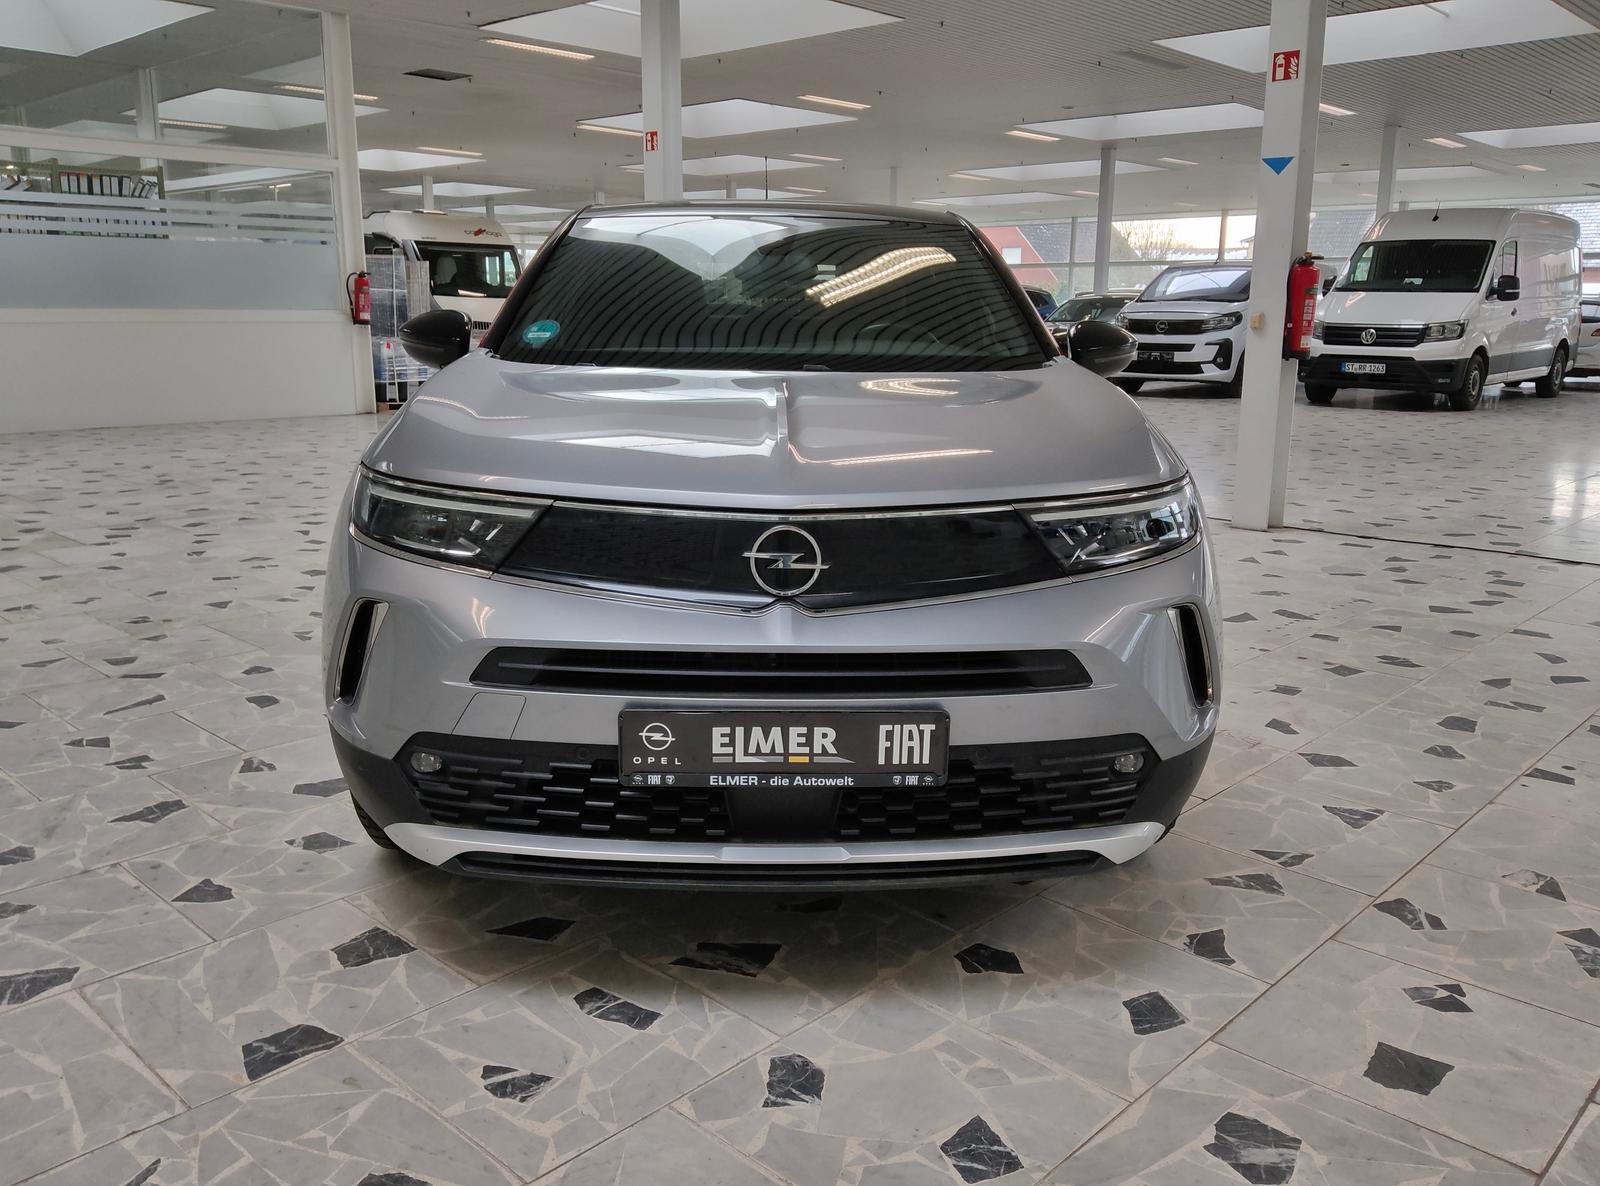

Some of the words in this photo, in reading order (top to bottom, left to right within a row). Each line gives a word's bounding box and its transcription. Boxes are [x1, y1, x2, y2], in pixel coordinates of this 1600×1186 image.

[712, 726, 838, 763] ELMER
[878, 724, 936, 765] FIAT
[633, 756, 681, 765] OPEL
[648, 775, 661, 784] FIAT
[709, 775, 758, 786] ELMER
[770, 776, 789, 786] die
[793, 776, 854, 786] Autowelt
[906, 775, 919, 785] FIAT
